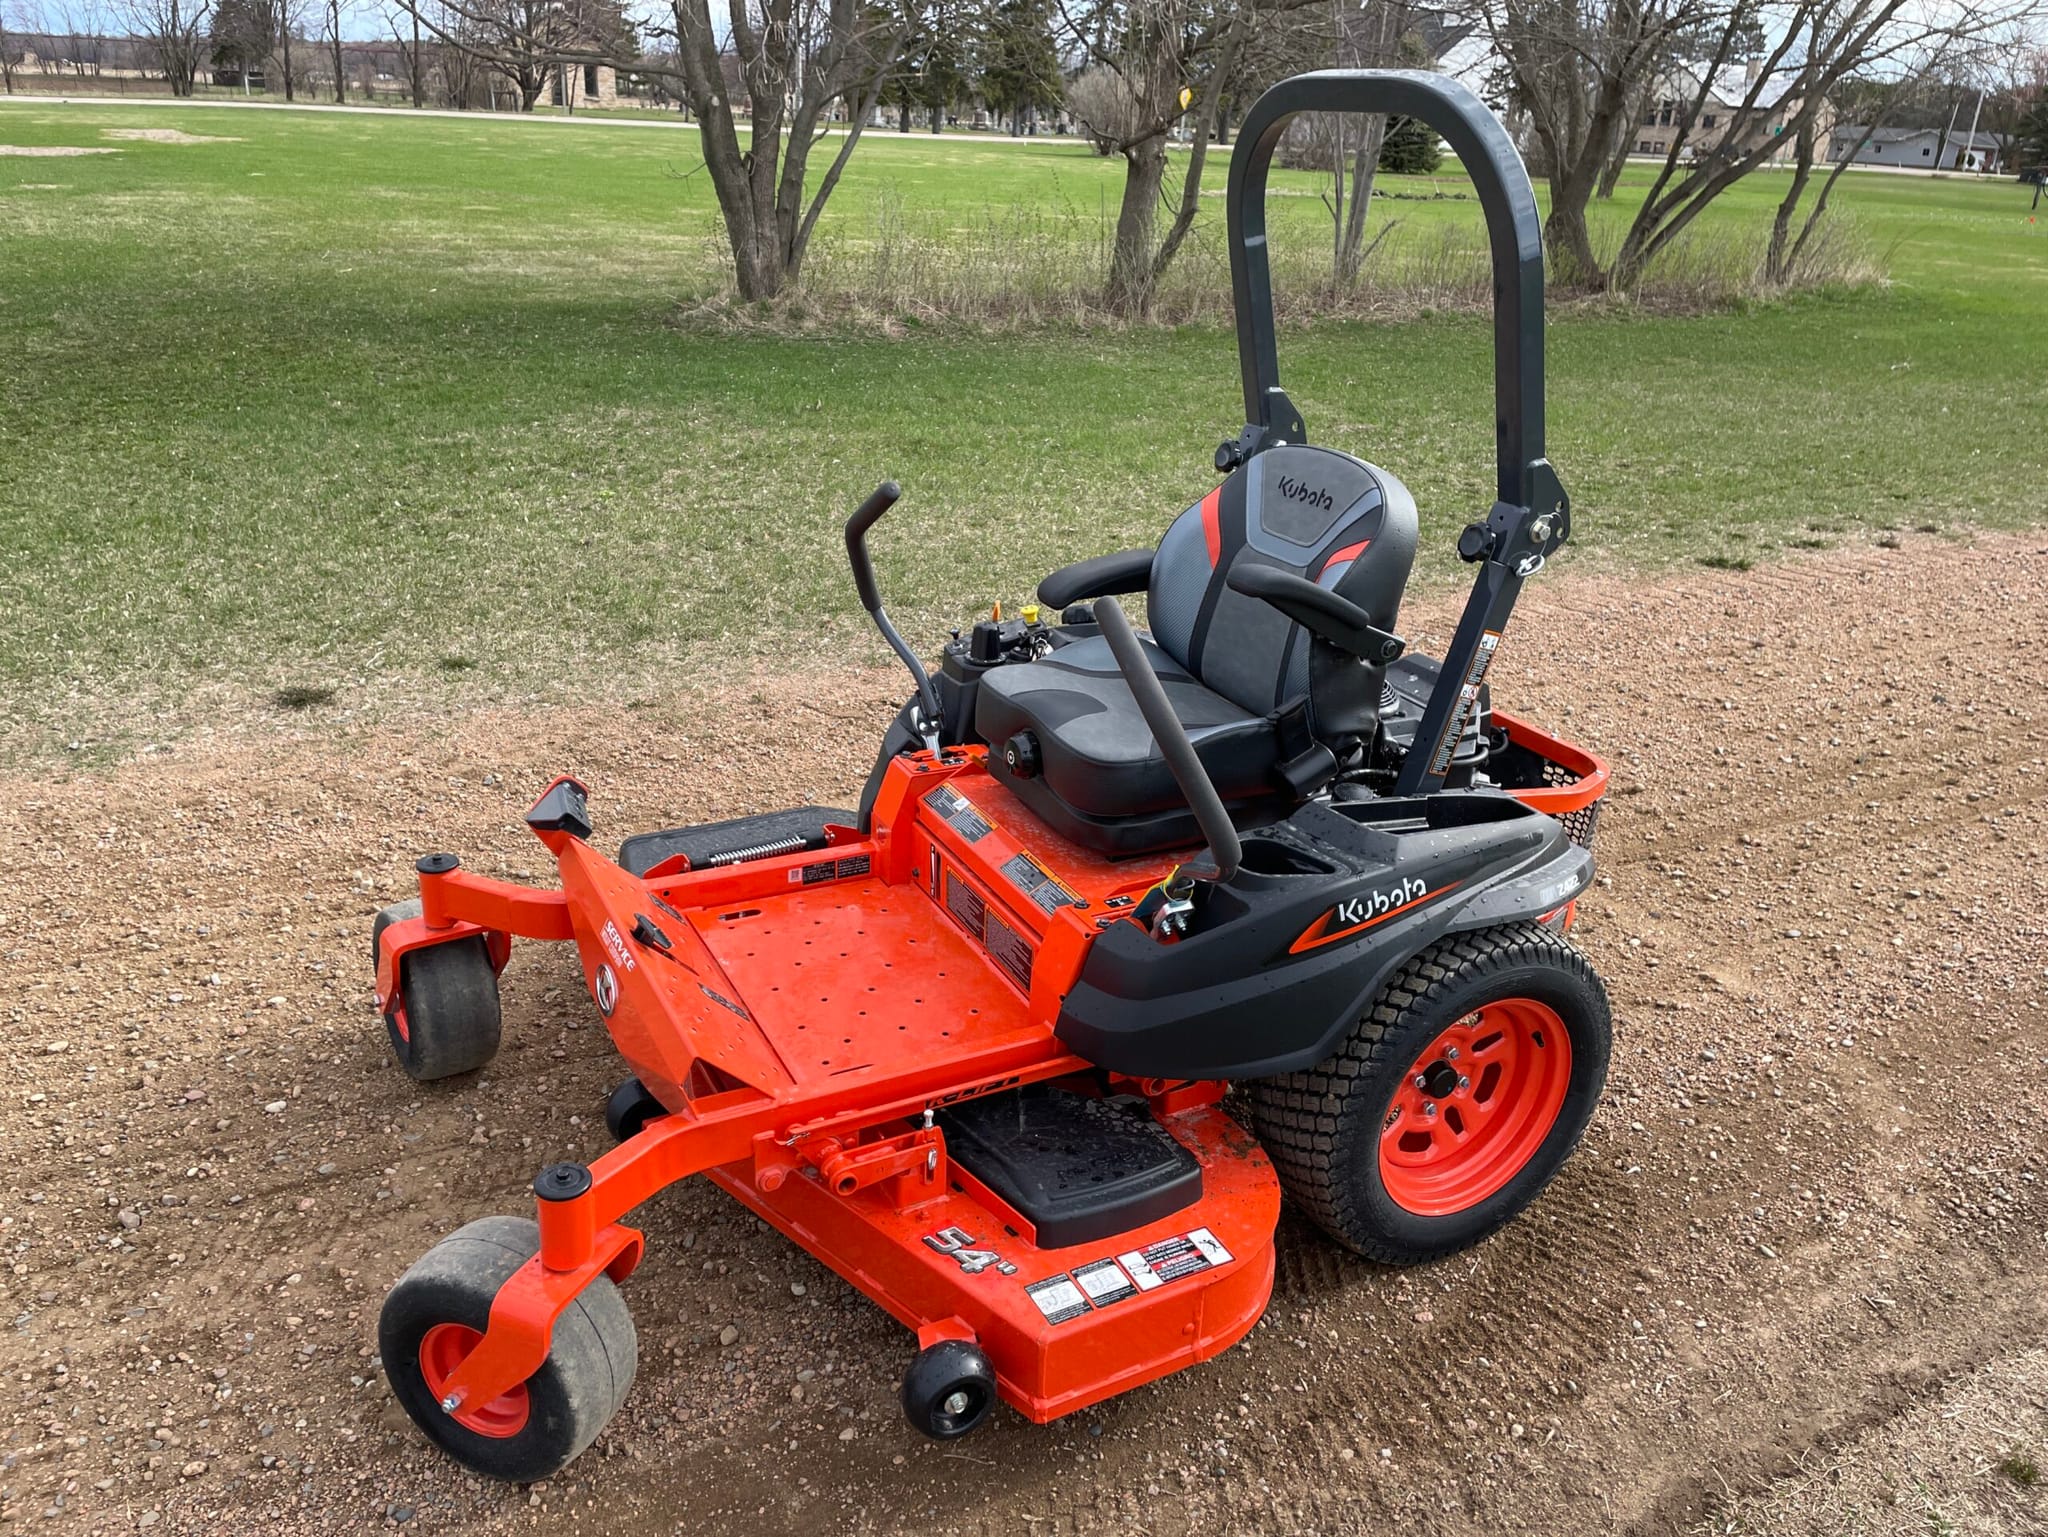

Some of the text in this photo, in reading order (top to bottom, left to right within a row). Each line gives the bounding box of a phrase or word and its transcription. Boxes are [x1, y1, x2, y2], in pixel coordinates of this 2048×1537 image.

[1278, 475, 1333, 511] Kubota
[1338, 877, 1427, 924] Kubota
[605, 920, 635, 972] SERVICE
